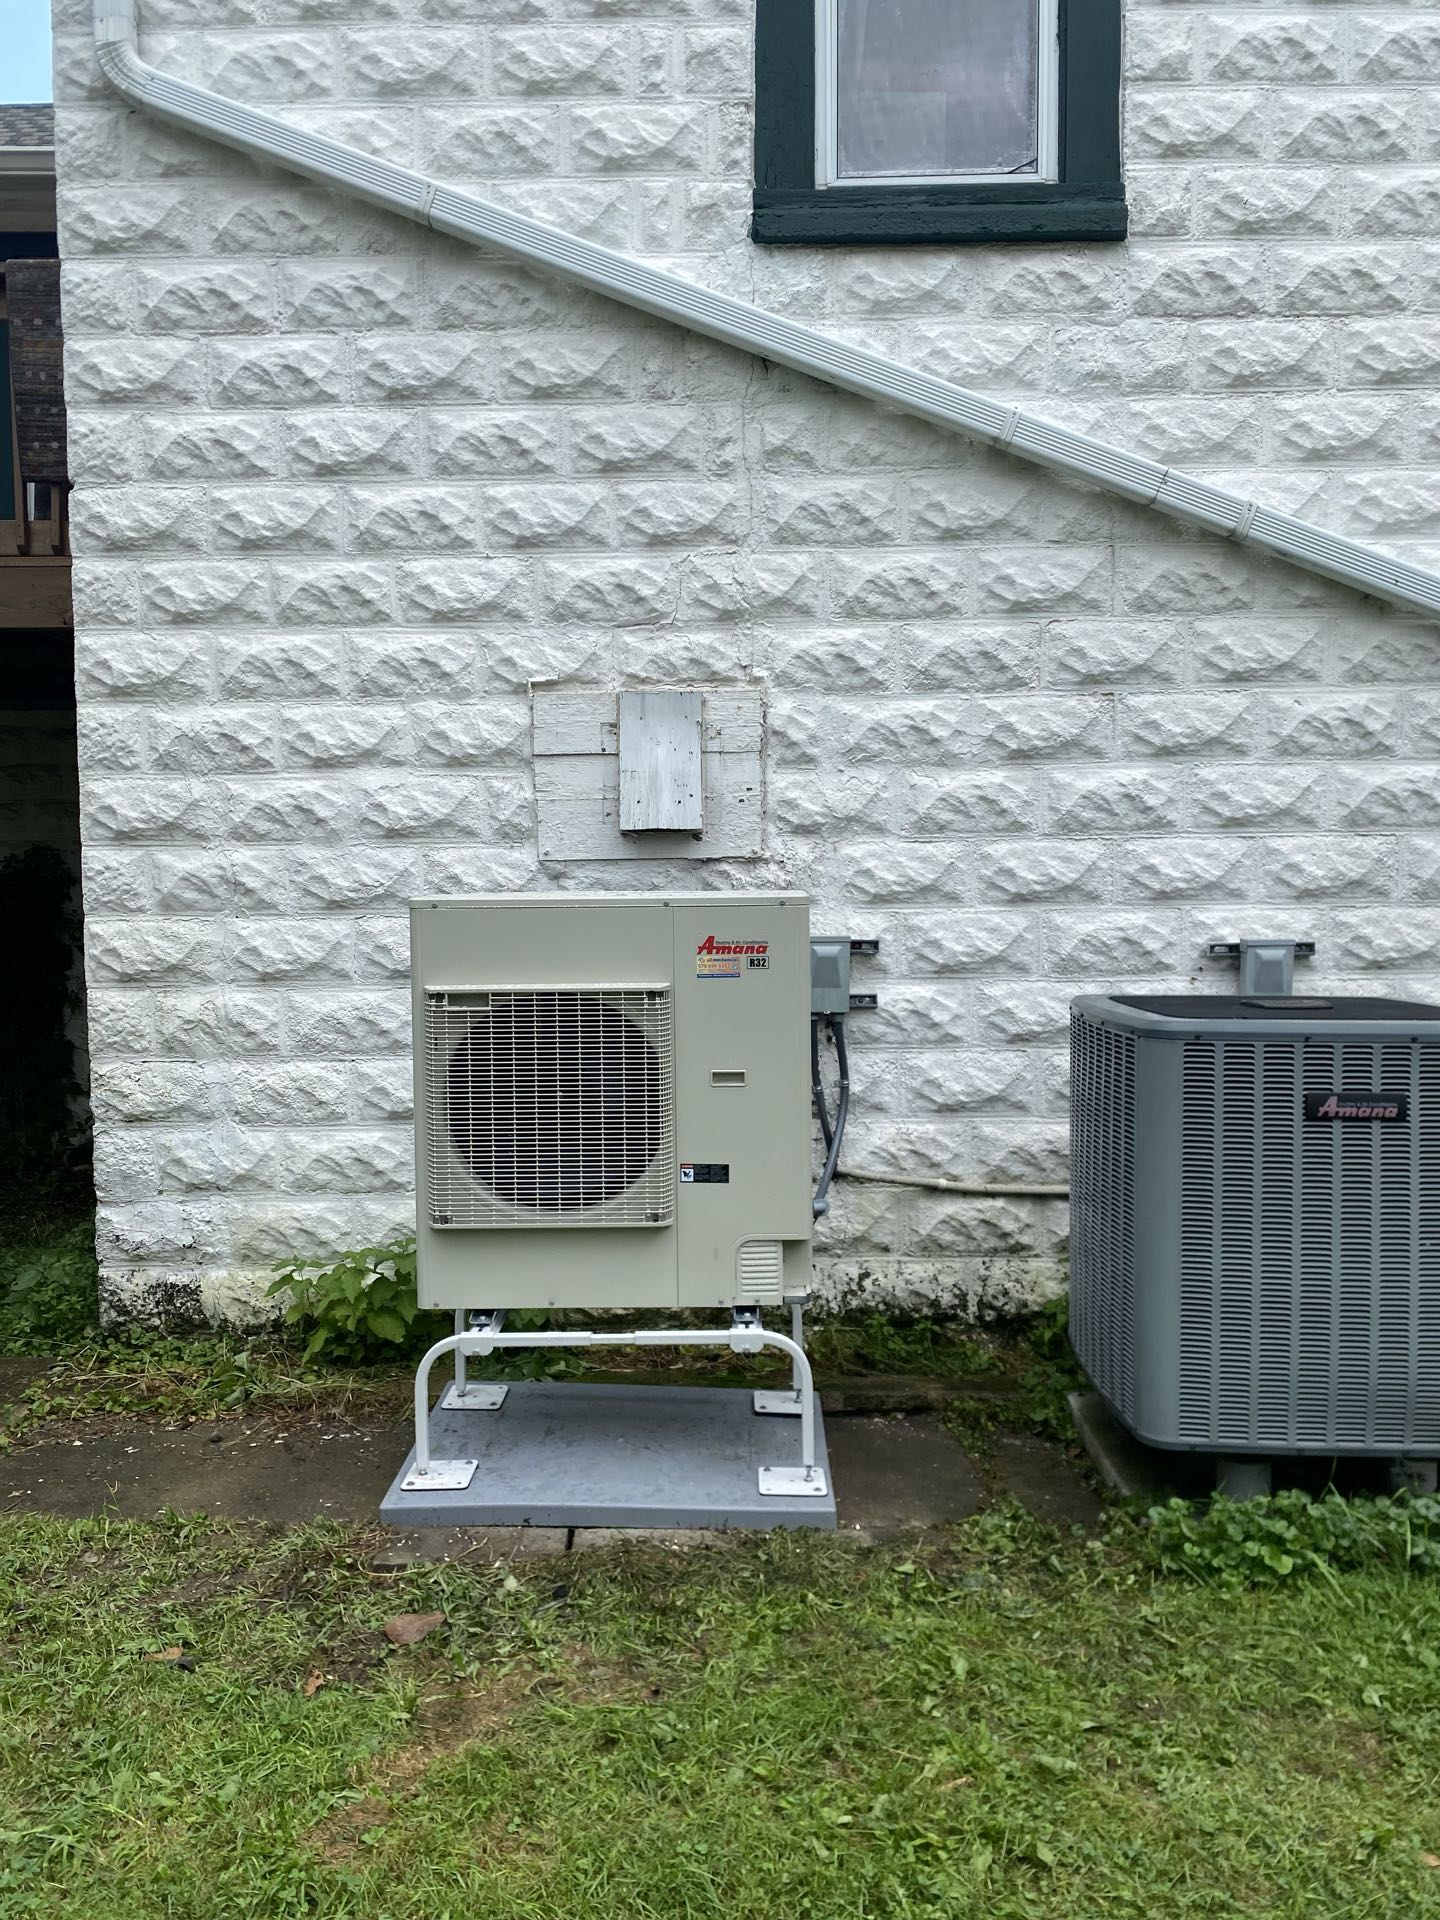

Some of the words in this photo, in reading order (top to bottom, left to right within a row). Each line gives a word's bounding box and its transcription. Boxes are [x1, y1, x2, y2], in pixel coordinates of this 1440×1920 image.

[697, 935, 769, 955] Amana
[749, 957, 767, 968] R32
[1317, 1095, 1398, 1118] Amana
